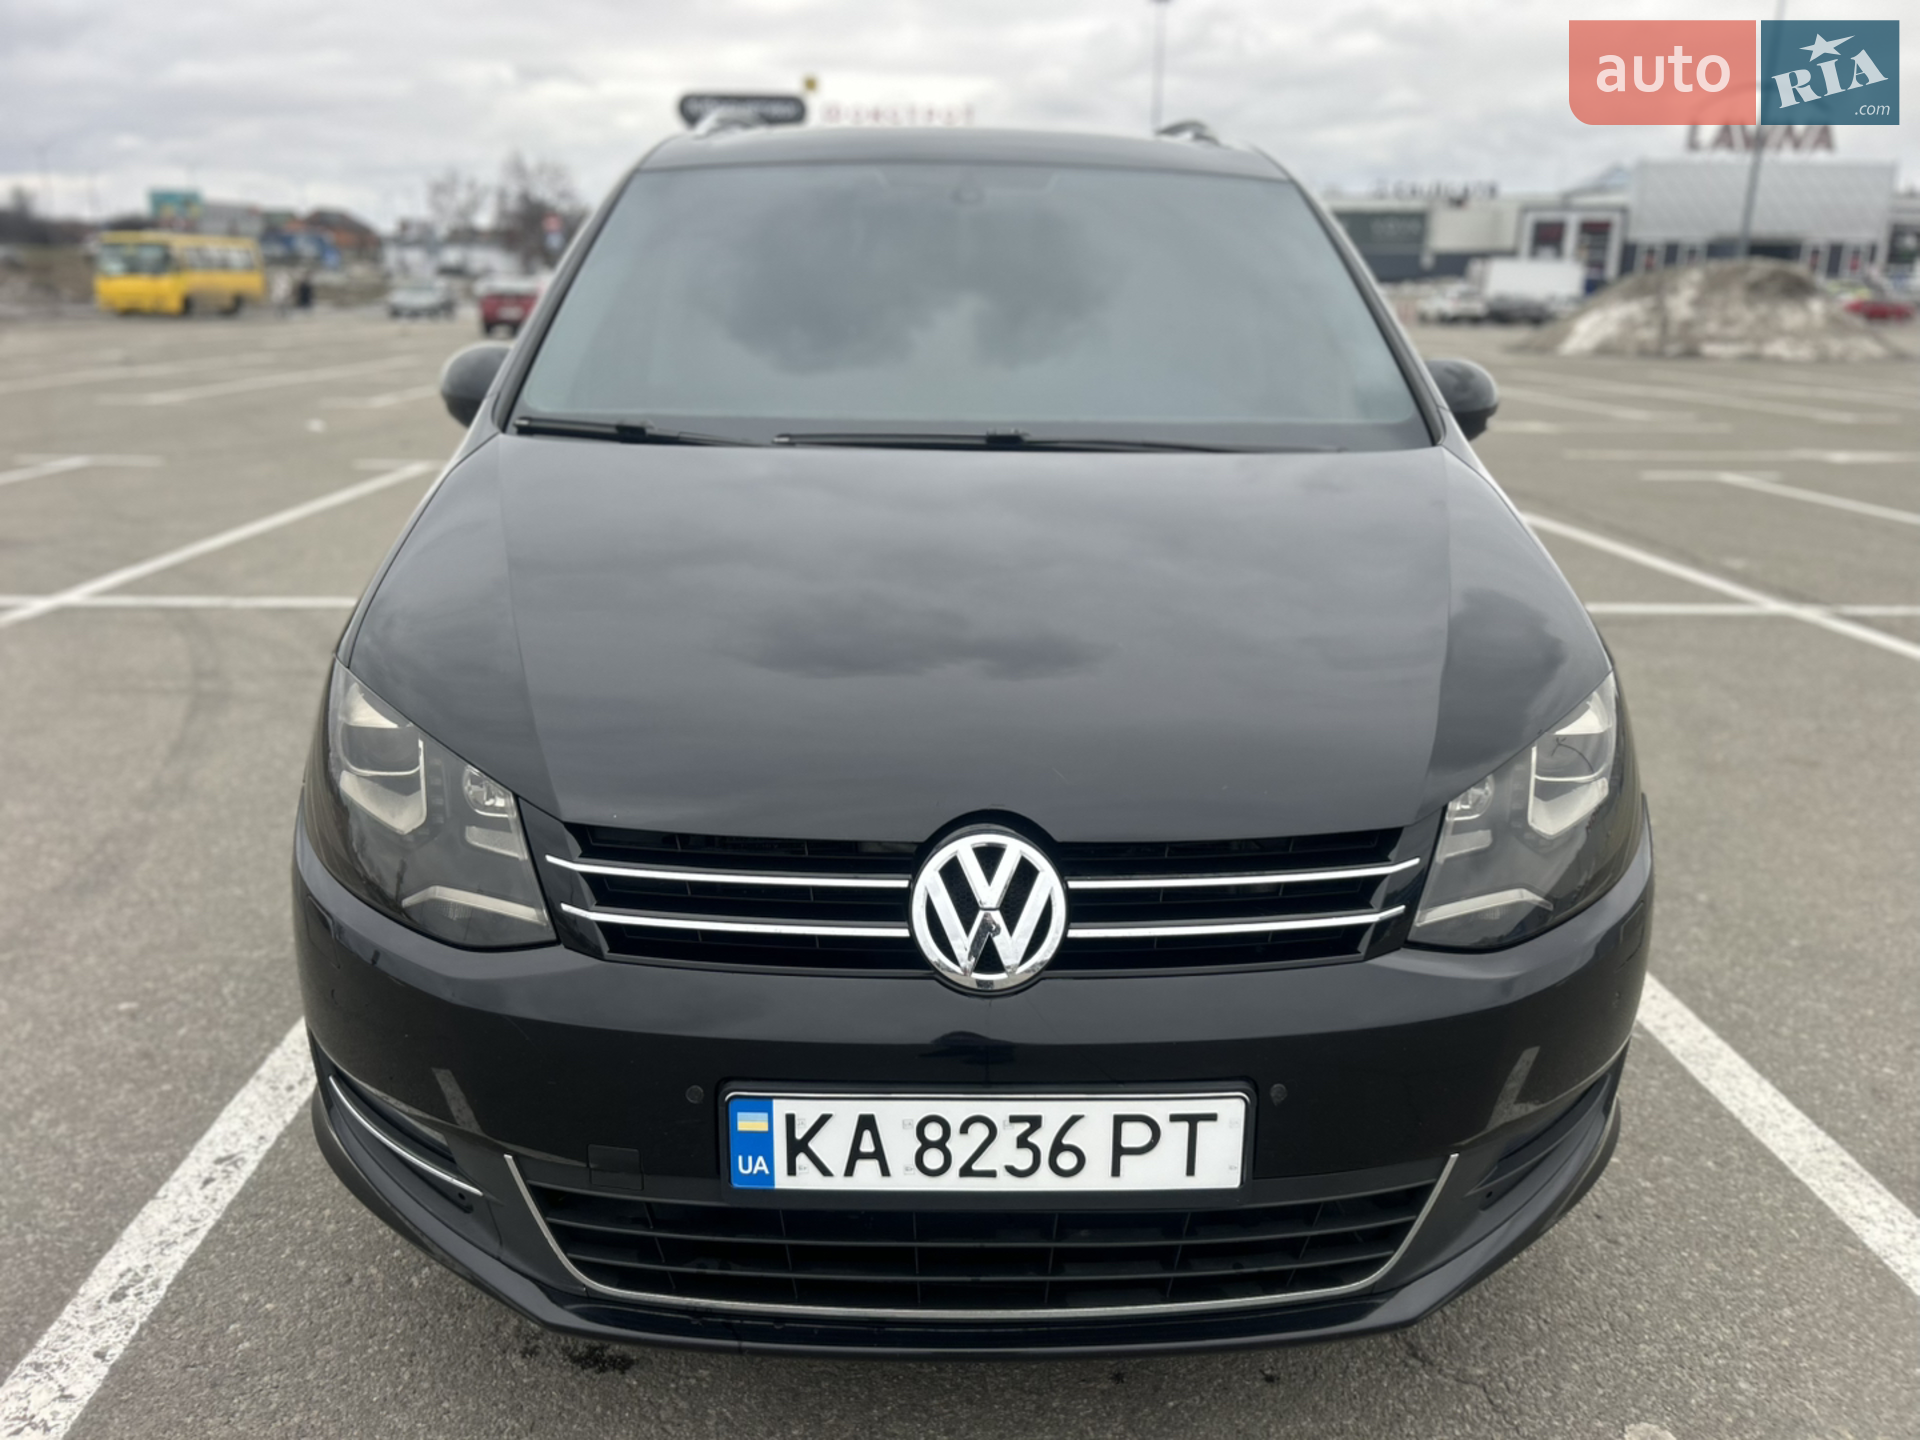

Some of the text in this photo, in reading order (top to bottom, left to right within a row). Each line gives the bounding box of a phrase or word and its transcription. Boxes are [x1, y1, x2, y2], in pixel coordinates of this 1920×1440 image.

[911, 833, 1067, 991] VW
[737, 1155, 770, 1175] UA
[785, 1112, 1218, 1178] KA 8236 PT
